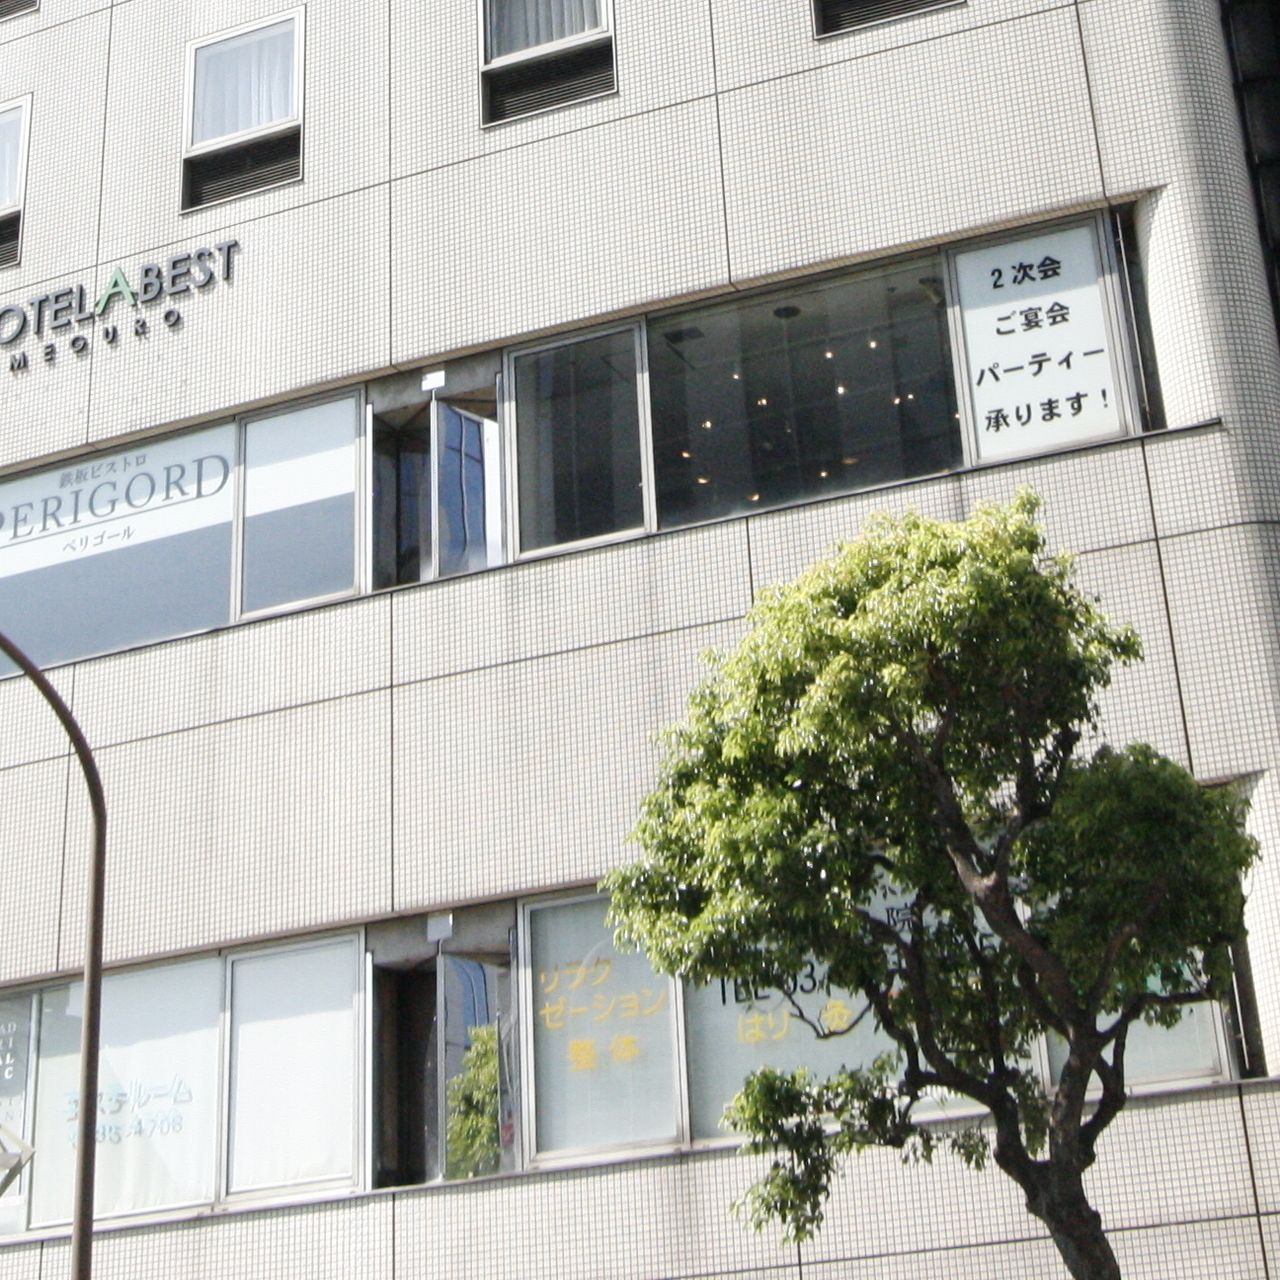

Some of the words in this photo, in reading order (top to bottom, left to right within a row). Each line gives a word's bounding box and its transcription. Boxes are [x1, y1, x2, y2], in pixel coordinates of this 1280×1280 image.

[990, 256, 1062, 290] 2次会
[996, 301, 1070, 336] ご宴会
[9, 308, 182, 371] MEGURO
[976, 347, 1105, 386] パーティー
